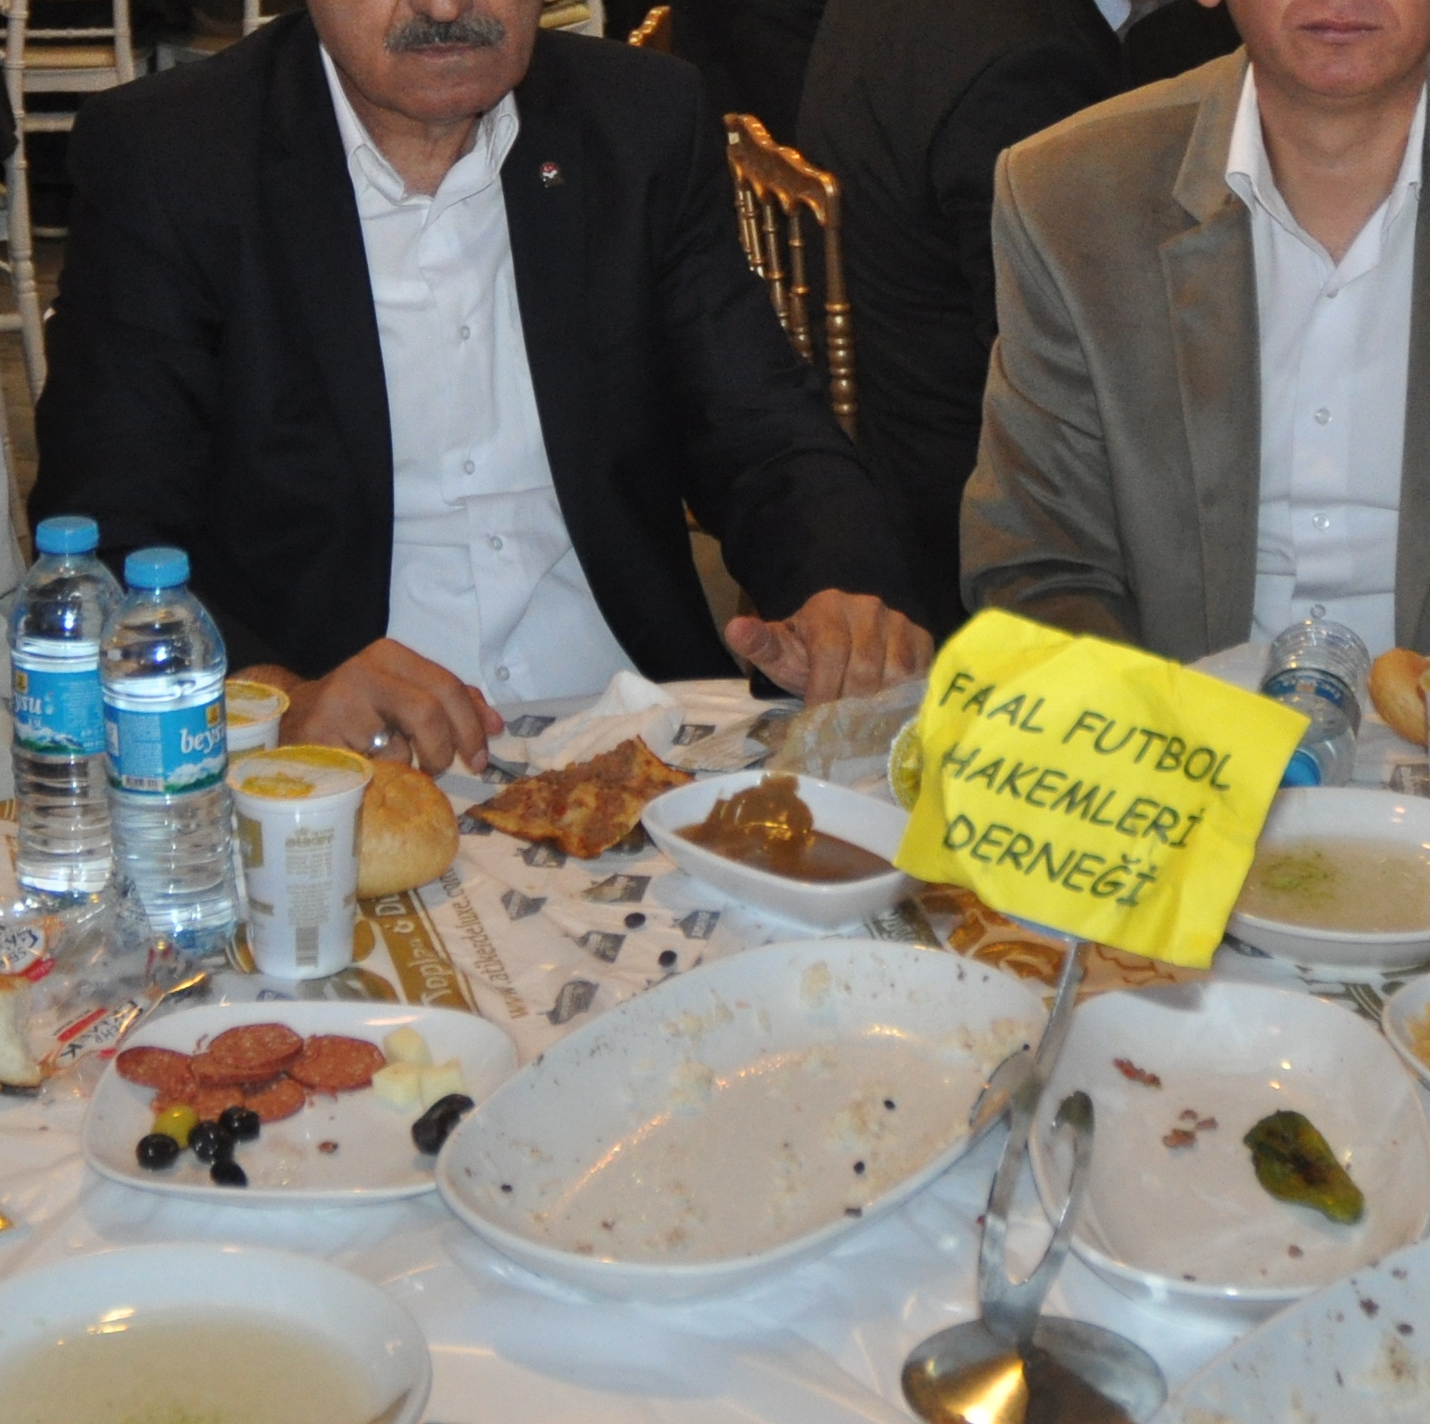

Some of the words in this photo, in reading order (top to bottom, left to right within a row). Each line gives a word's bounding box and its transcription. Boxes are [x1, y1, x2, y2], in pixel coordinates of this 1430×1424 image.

[938, 671, 1046, 736] FAAL
[1061, 709, 1233, 793] FUTBOL
[940, 740, 1206, 850] HAKEMLERİ
[941, 812, 1161, 908] DERNEĞİ
